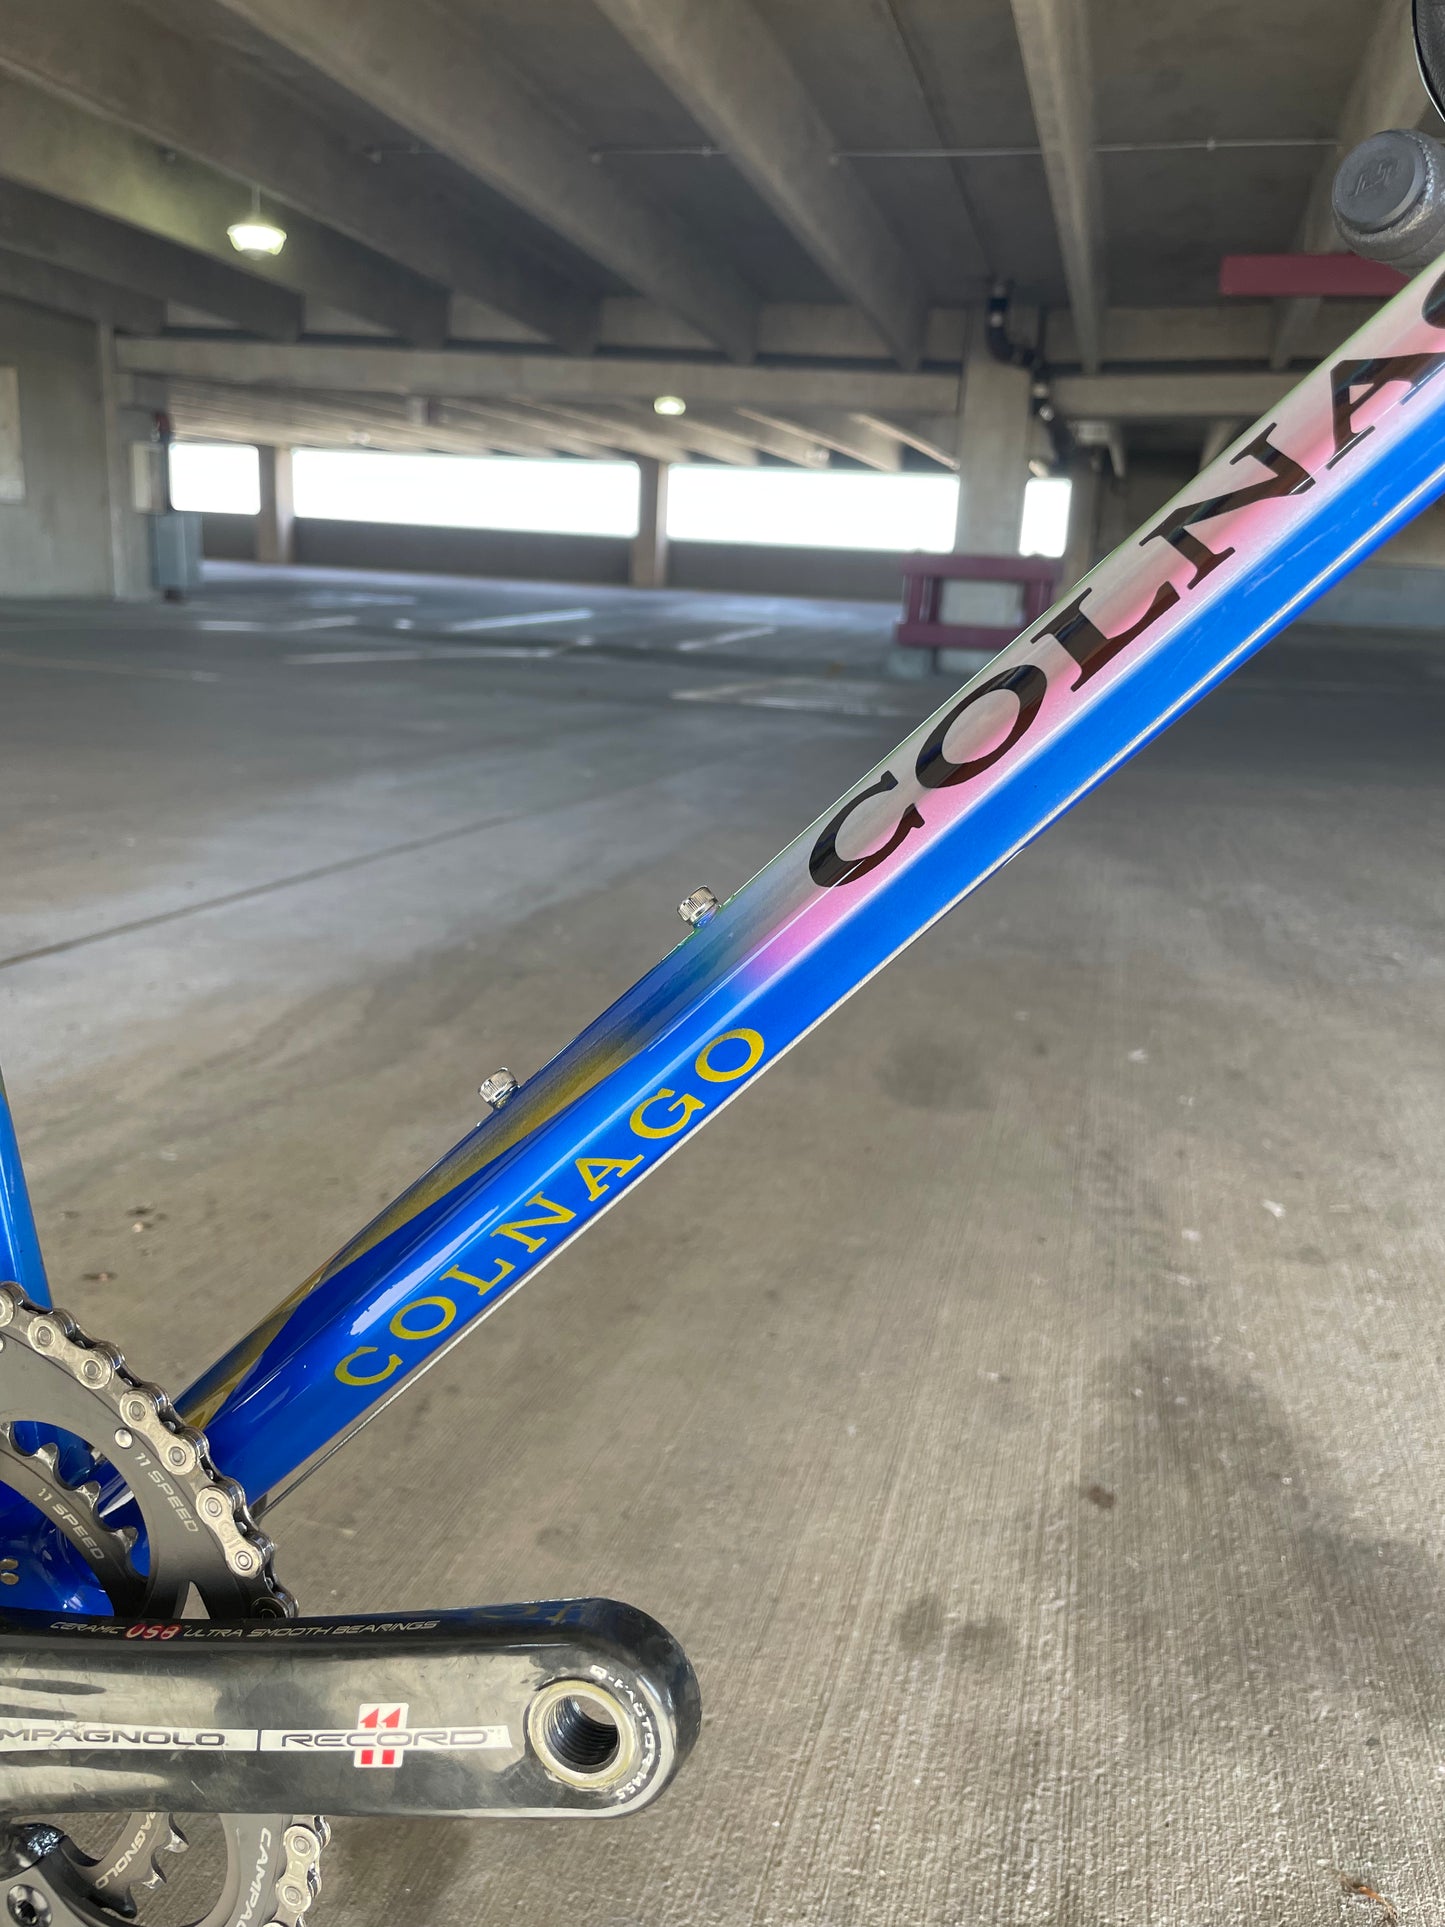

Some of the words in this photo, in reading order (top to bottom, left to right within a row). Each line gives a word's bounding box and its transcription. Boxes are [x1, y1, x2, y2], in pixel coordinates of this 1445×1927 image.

[809, 270, 1445, 888] COLNA
[334, 1028, 765, 1386] COLNAGO
[37, 1488, 53, 1502] 11
[52, 1503, 105, 1560] SPEED
[134, 1453, 151, 1467] 11
[147, 1470, 199, 1532] SPEED
[50, 1621, 125, 1635] CERAMIC
[183, 1628, 244, 1638] ULTRA
[247, 1627, 334, 1638] SMOOTH
[332, 1620, 441, 1635] BEARINGS
